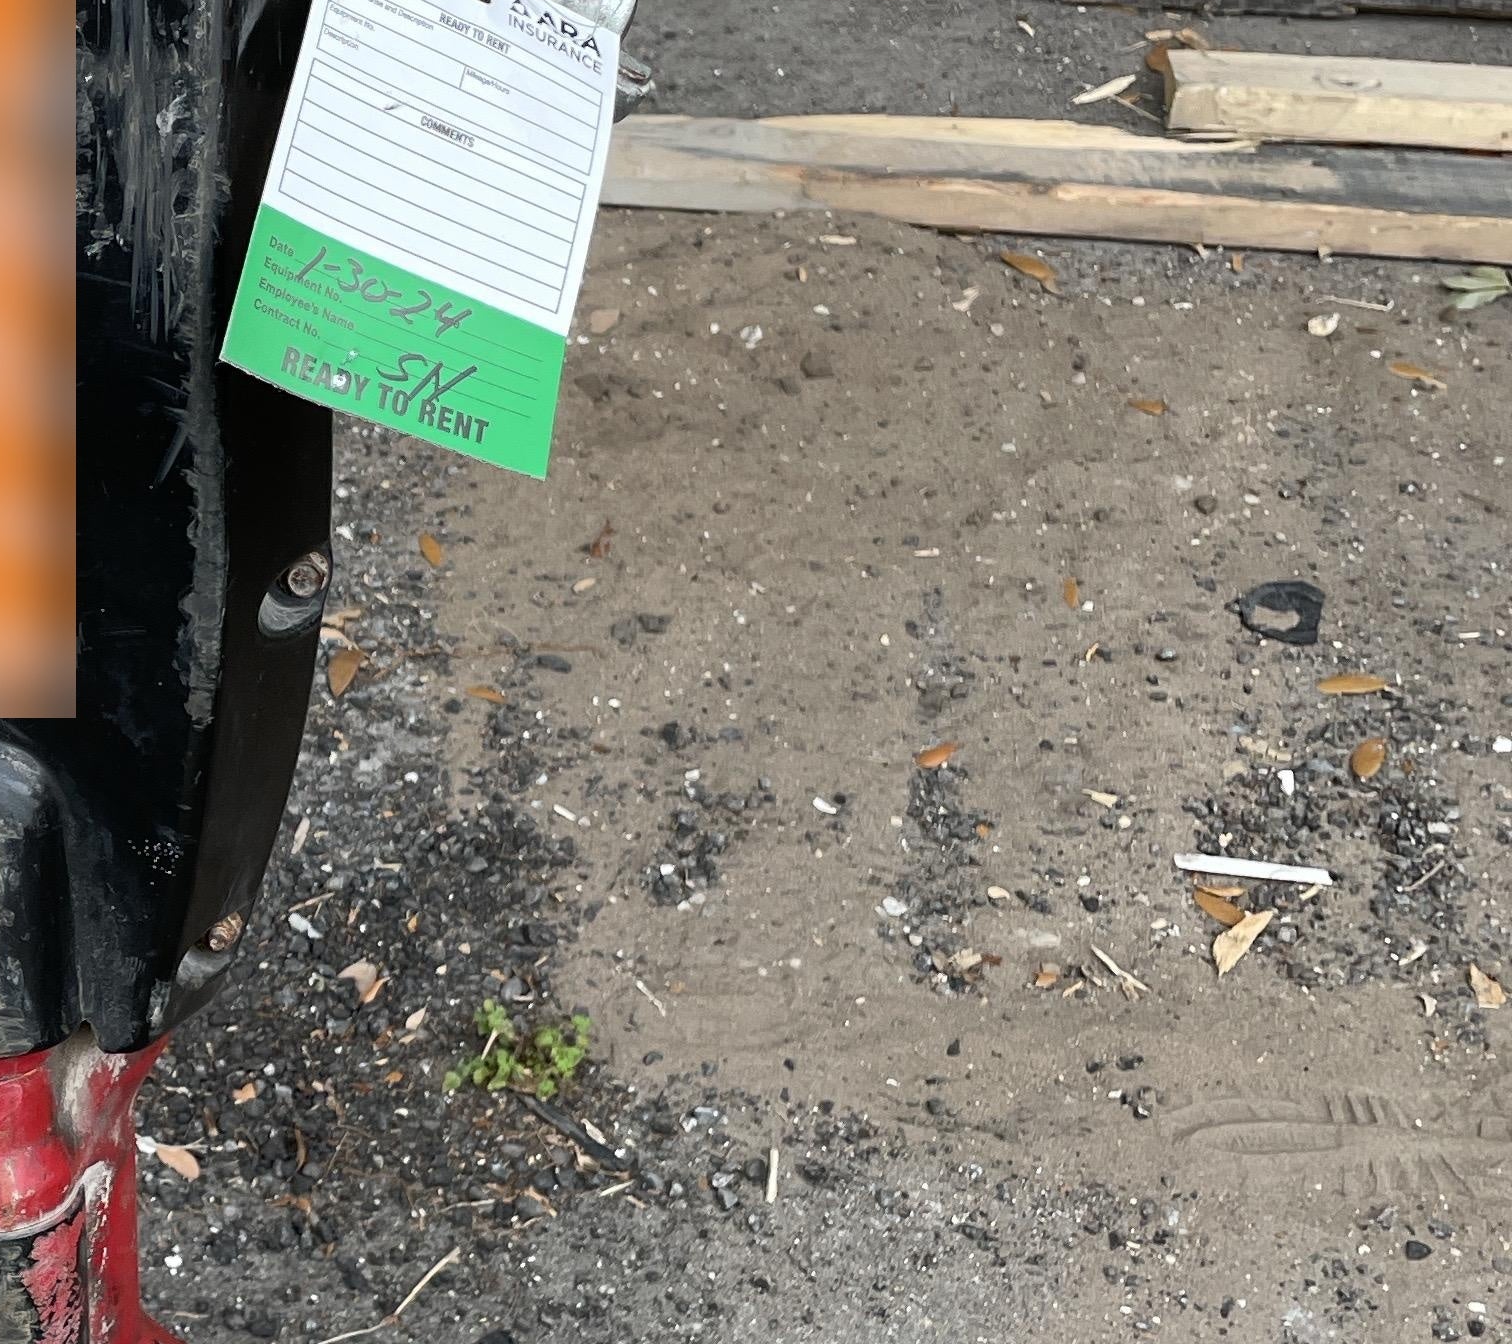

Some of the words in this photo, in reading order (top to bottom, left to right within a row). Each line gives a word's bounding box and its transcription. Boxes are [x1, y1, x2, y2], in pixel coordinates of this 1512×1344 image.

[439, 12, 471, 36] READY
[472, 25, 485, 41] TO
[485, 30, 511, 55] RENT
[508, 13, 603, 75] INSURANCE
[420, 115, 475, 148] COMMENTS
[269, 235, 295, 257] Date
[263, 256, 324, 295] Equipment
[324, 287, 343, 304] No.
[253, 298, 302, 329] Contract
[303, 321, 321, 339] No.
[258, 277, 320, 316] Employee's
[321, 307, 355, 331] Name
[280, 346, 372, 402] READY
[377, 382, 409, 417] TO
[417, 397, 490, 444] RENT
